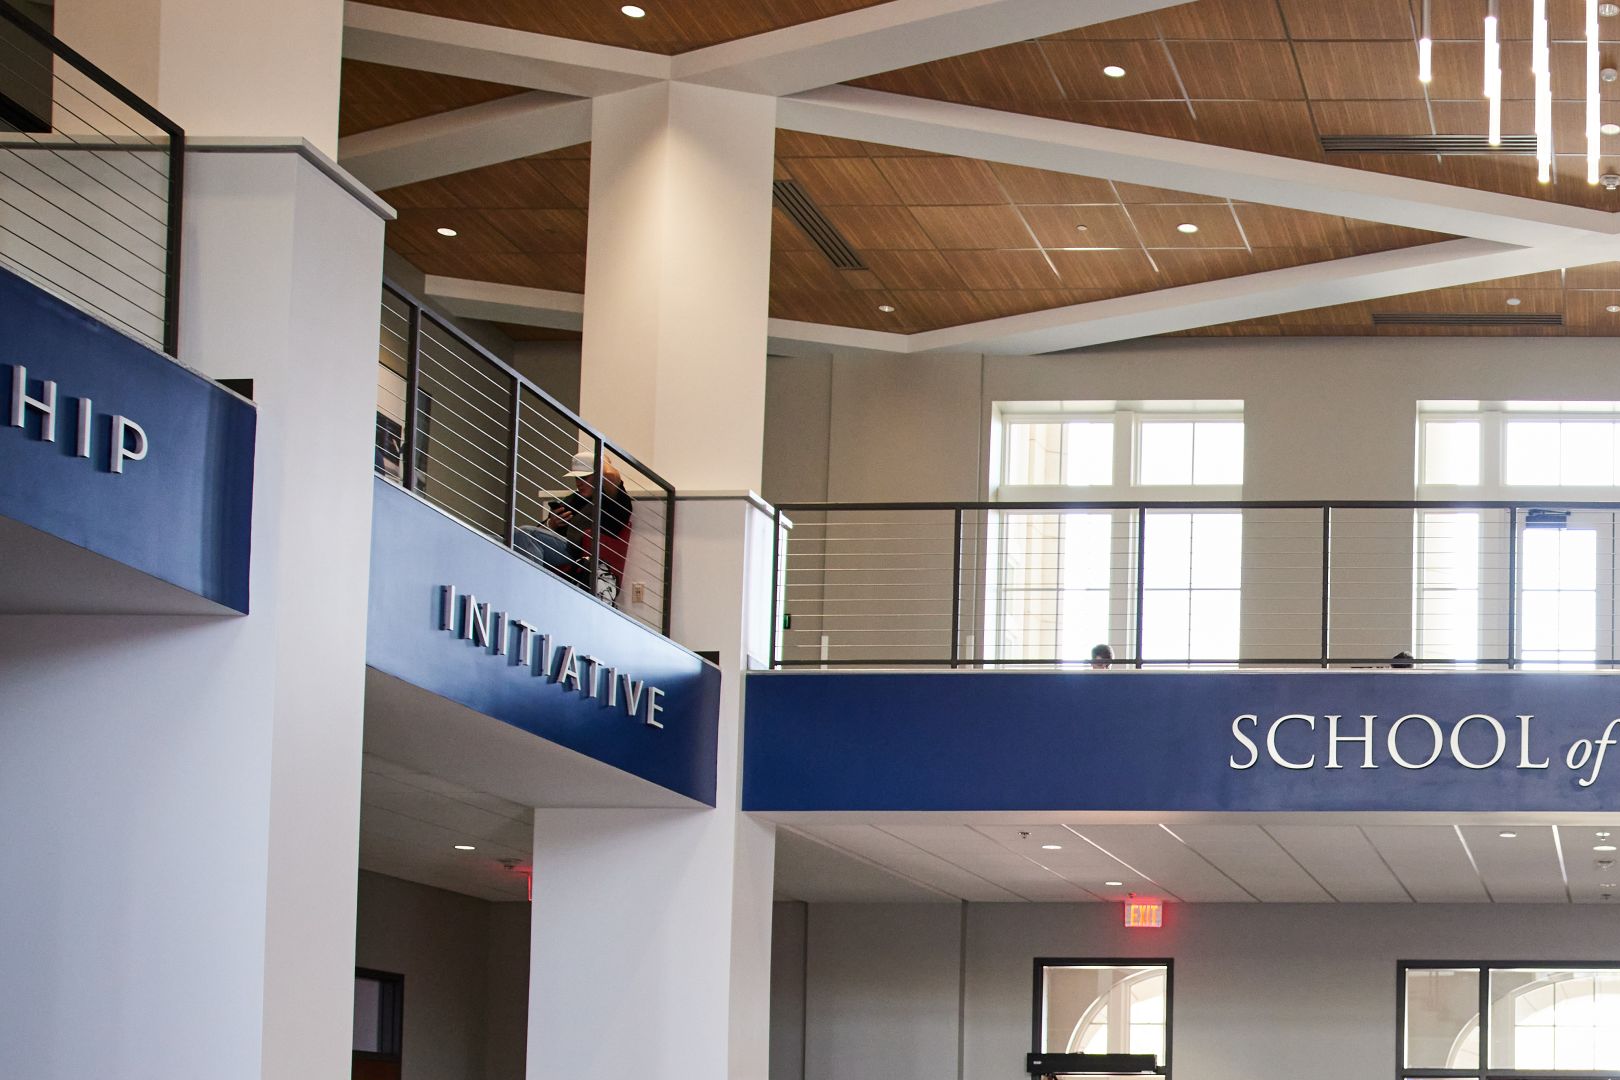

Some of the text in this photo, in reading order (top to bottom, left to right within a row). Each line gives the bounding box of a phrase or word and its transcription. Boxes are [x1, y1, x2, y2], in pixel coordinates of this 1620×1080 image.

[11, 365, 149, 474] HIP
[440, 584, 665, 729] INITIATIVE
[1229, 713, 1550, 770] SCHOOL
[1130, 904, 1159, 928] EXIT
